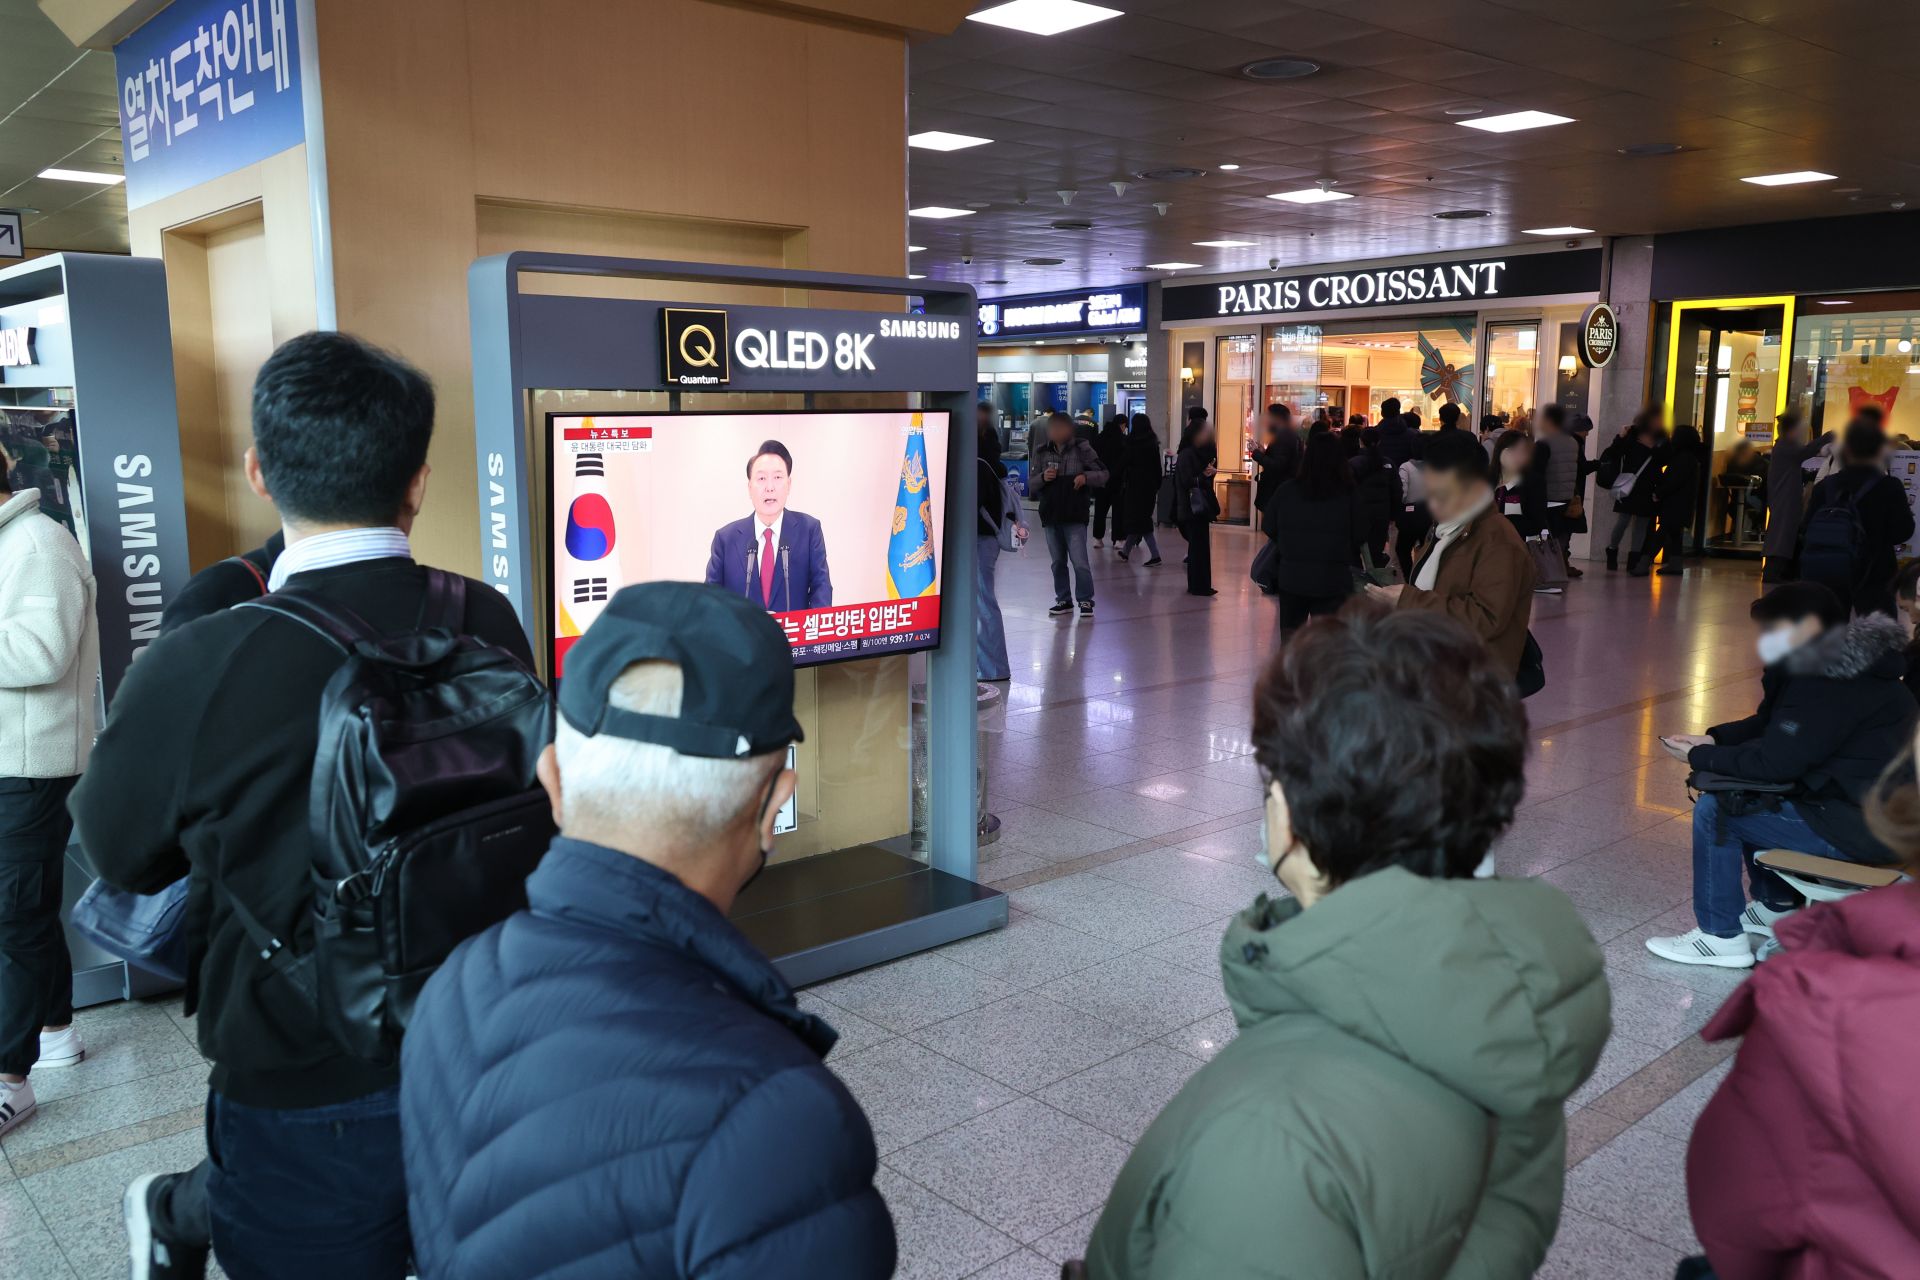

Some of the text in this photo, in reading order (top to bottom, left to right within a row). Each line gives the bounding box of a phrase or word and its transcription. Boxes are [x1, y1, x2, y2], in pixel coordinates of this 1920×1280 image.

[123, 0, 291, 163] 열차도착안내
[1218, 262, 1506, 315] PARIS CROISSANT
[679, 323, 719, 368] Q
[734, 327, 876, 371] QLED 8K
[880, 318, 960, 340] SAMSUNG
[1588, 327, 1613, 339] PARIS
[680, 374, 718, 385] Quantum
[580, 441, 605, 452] 대통령
[606, 441, 630, 451] 대국민
[631, 440, 647, 450] 담화
[113, 453, 163, 665] SAMSUN
[803, 608, 866, 641] 셀프방탄
[868, 600, 918, 632] 입법도"
[889, 633, 914, 645] 939.17
